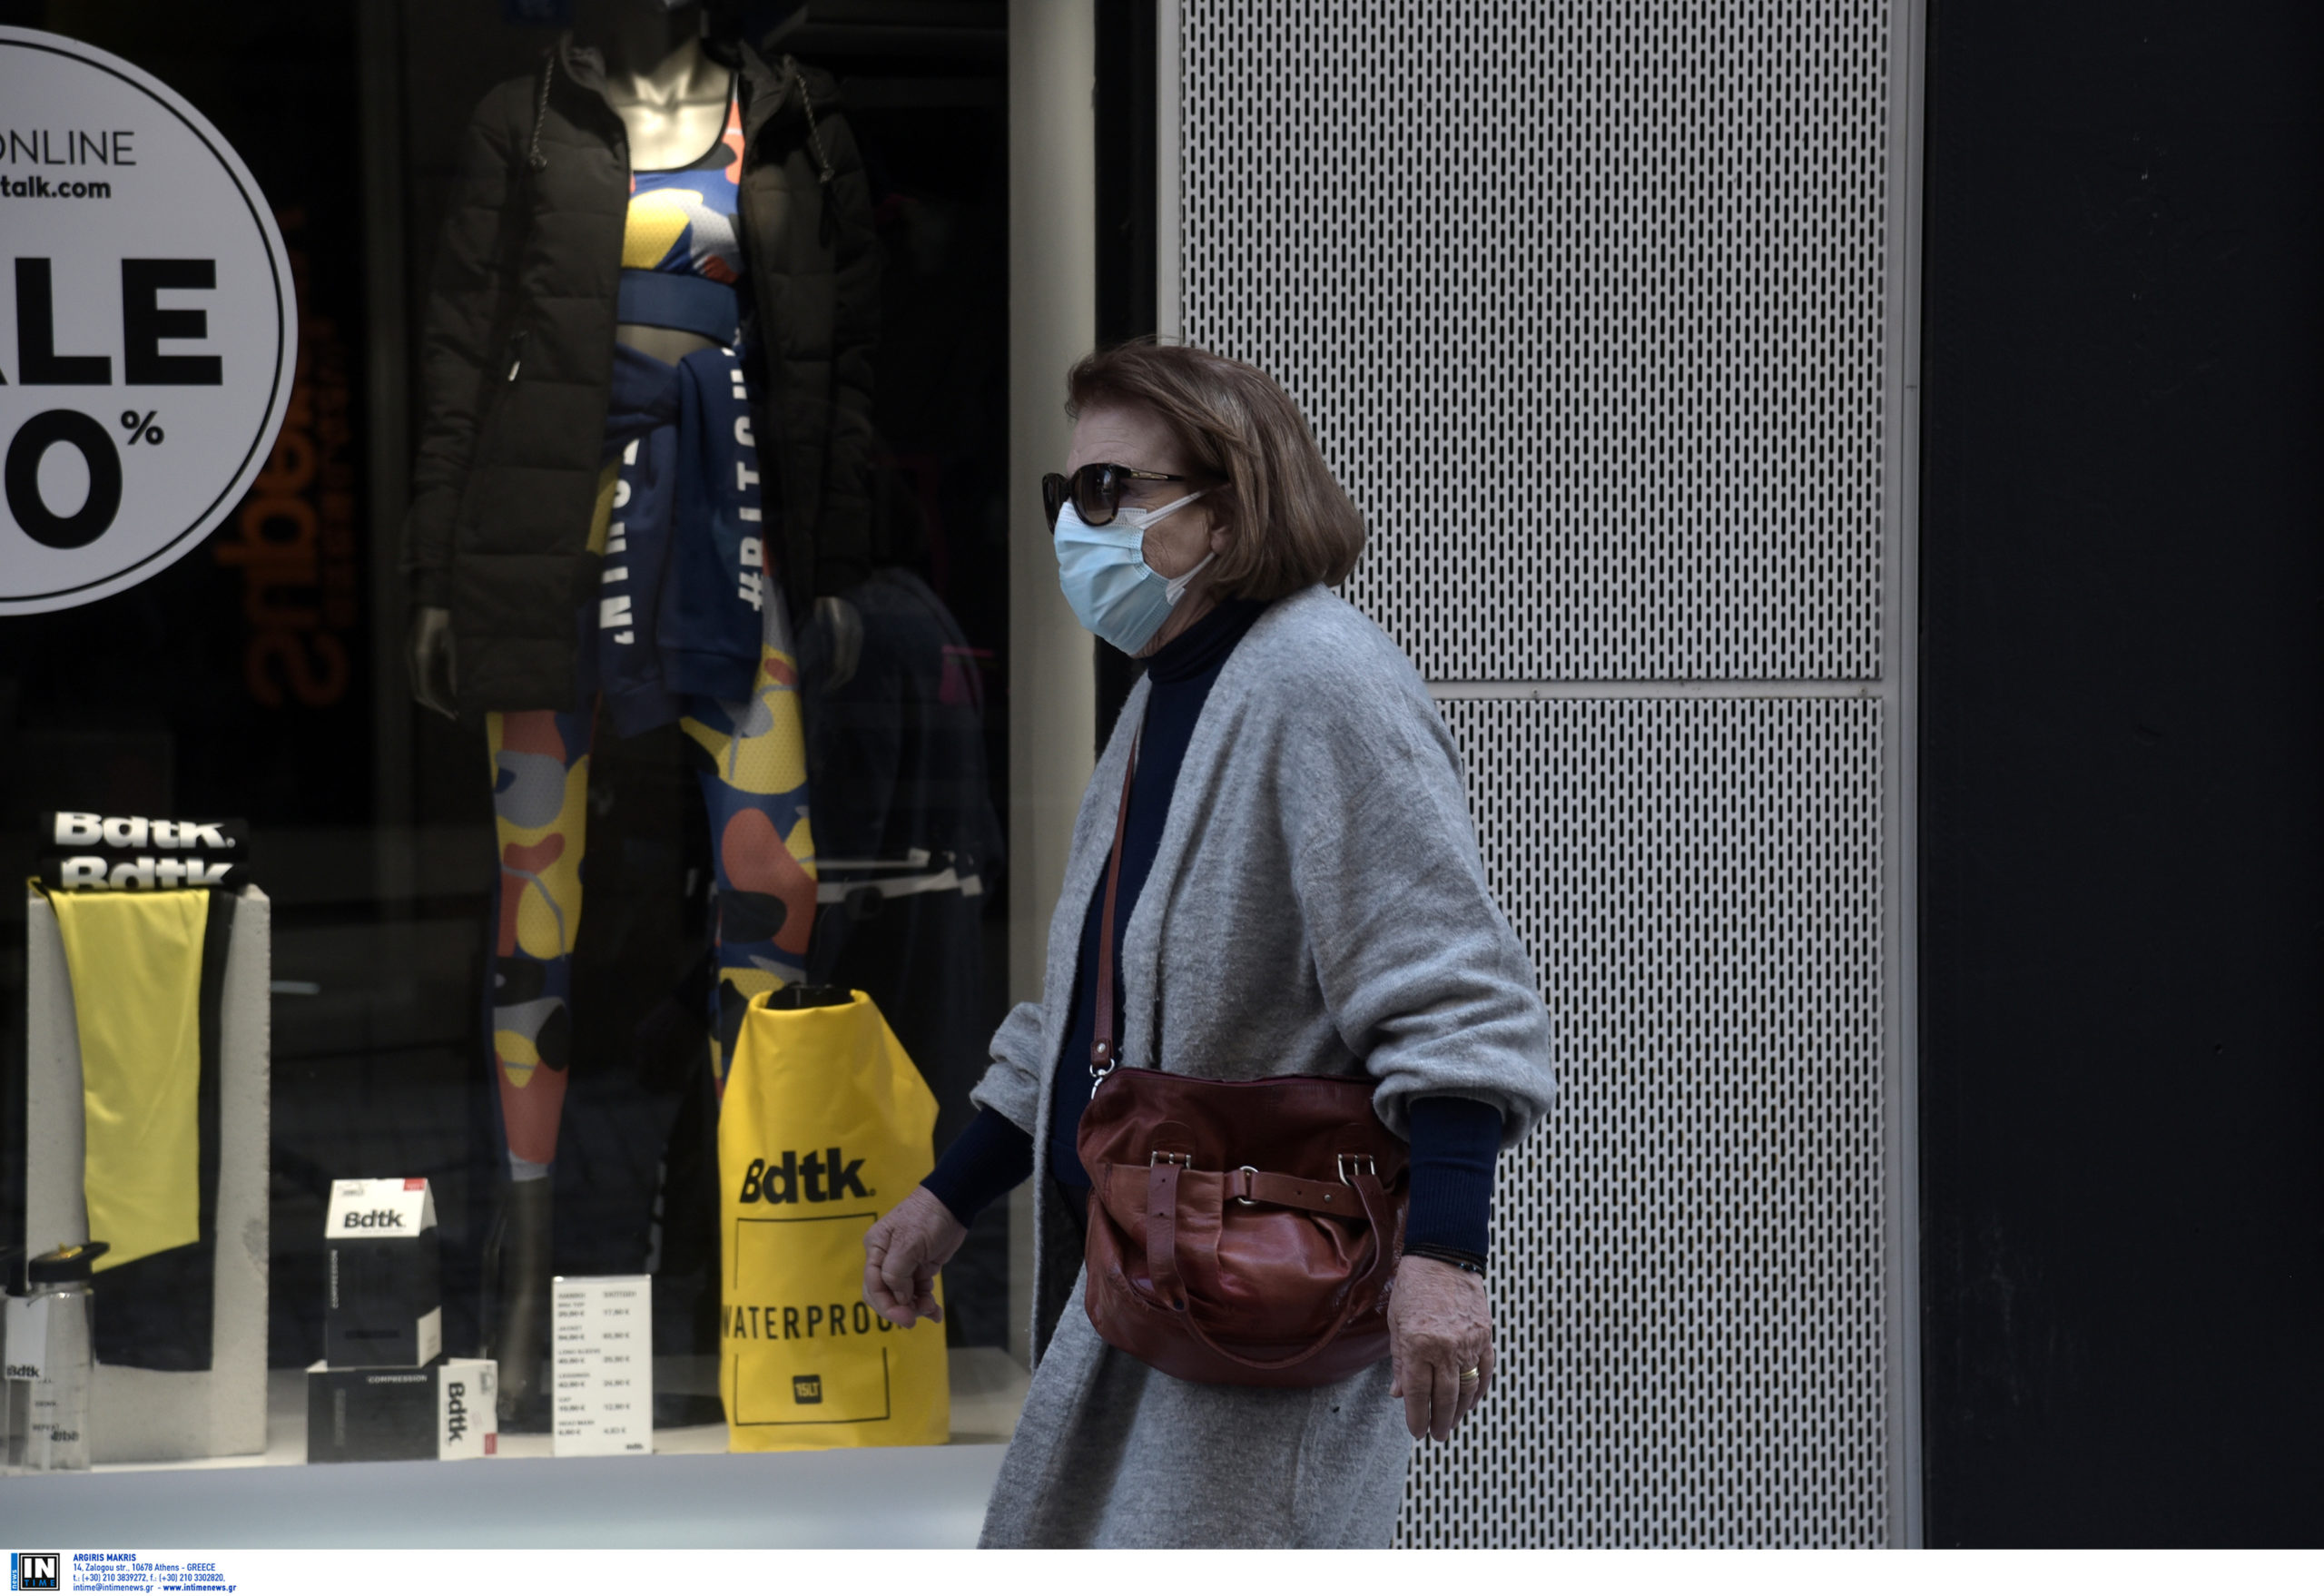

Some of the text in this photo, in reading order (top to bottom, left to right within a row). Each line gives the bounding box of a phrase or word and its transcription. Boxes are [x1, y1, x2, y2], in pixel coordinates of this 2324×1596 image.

[0, 129, 136, 165] NLINE
[0, 257, 223, 386] LE
[368, 1374, 428, 1384] COMPRESSION
